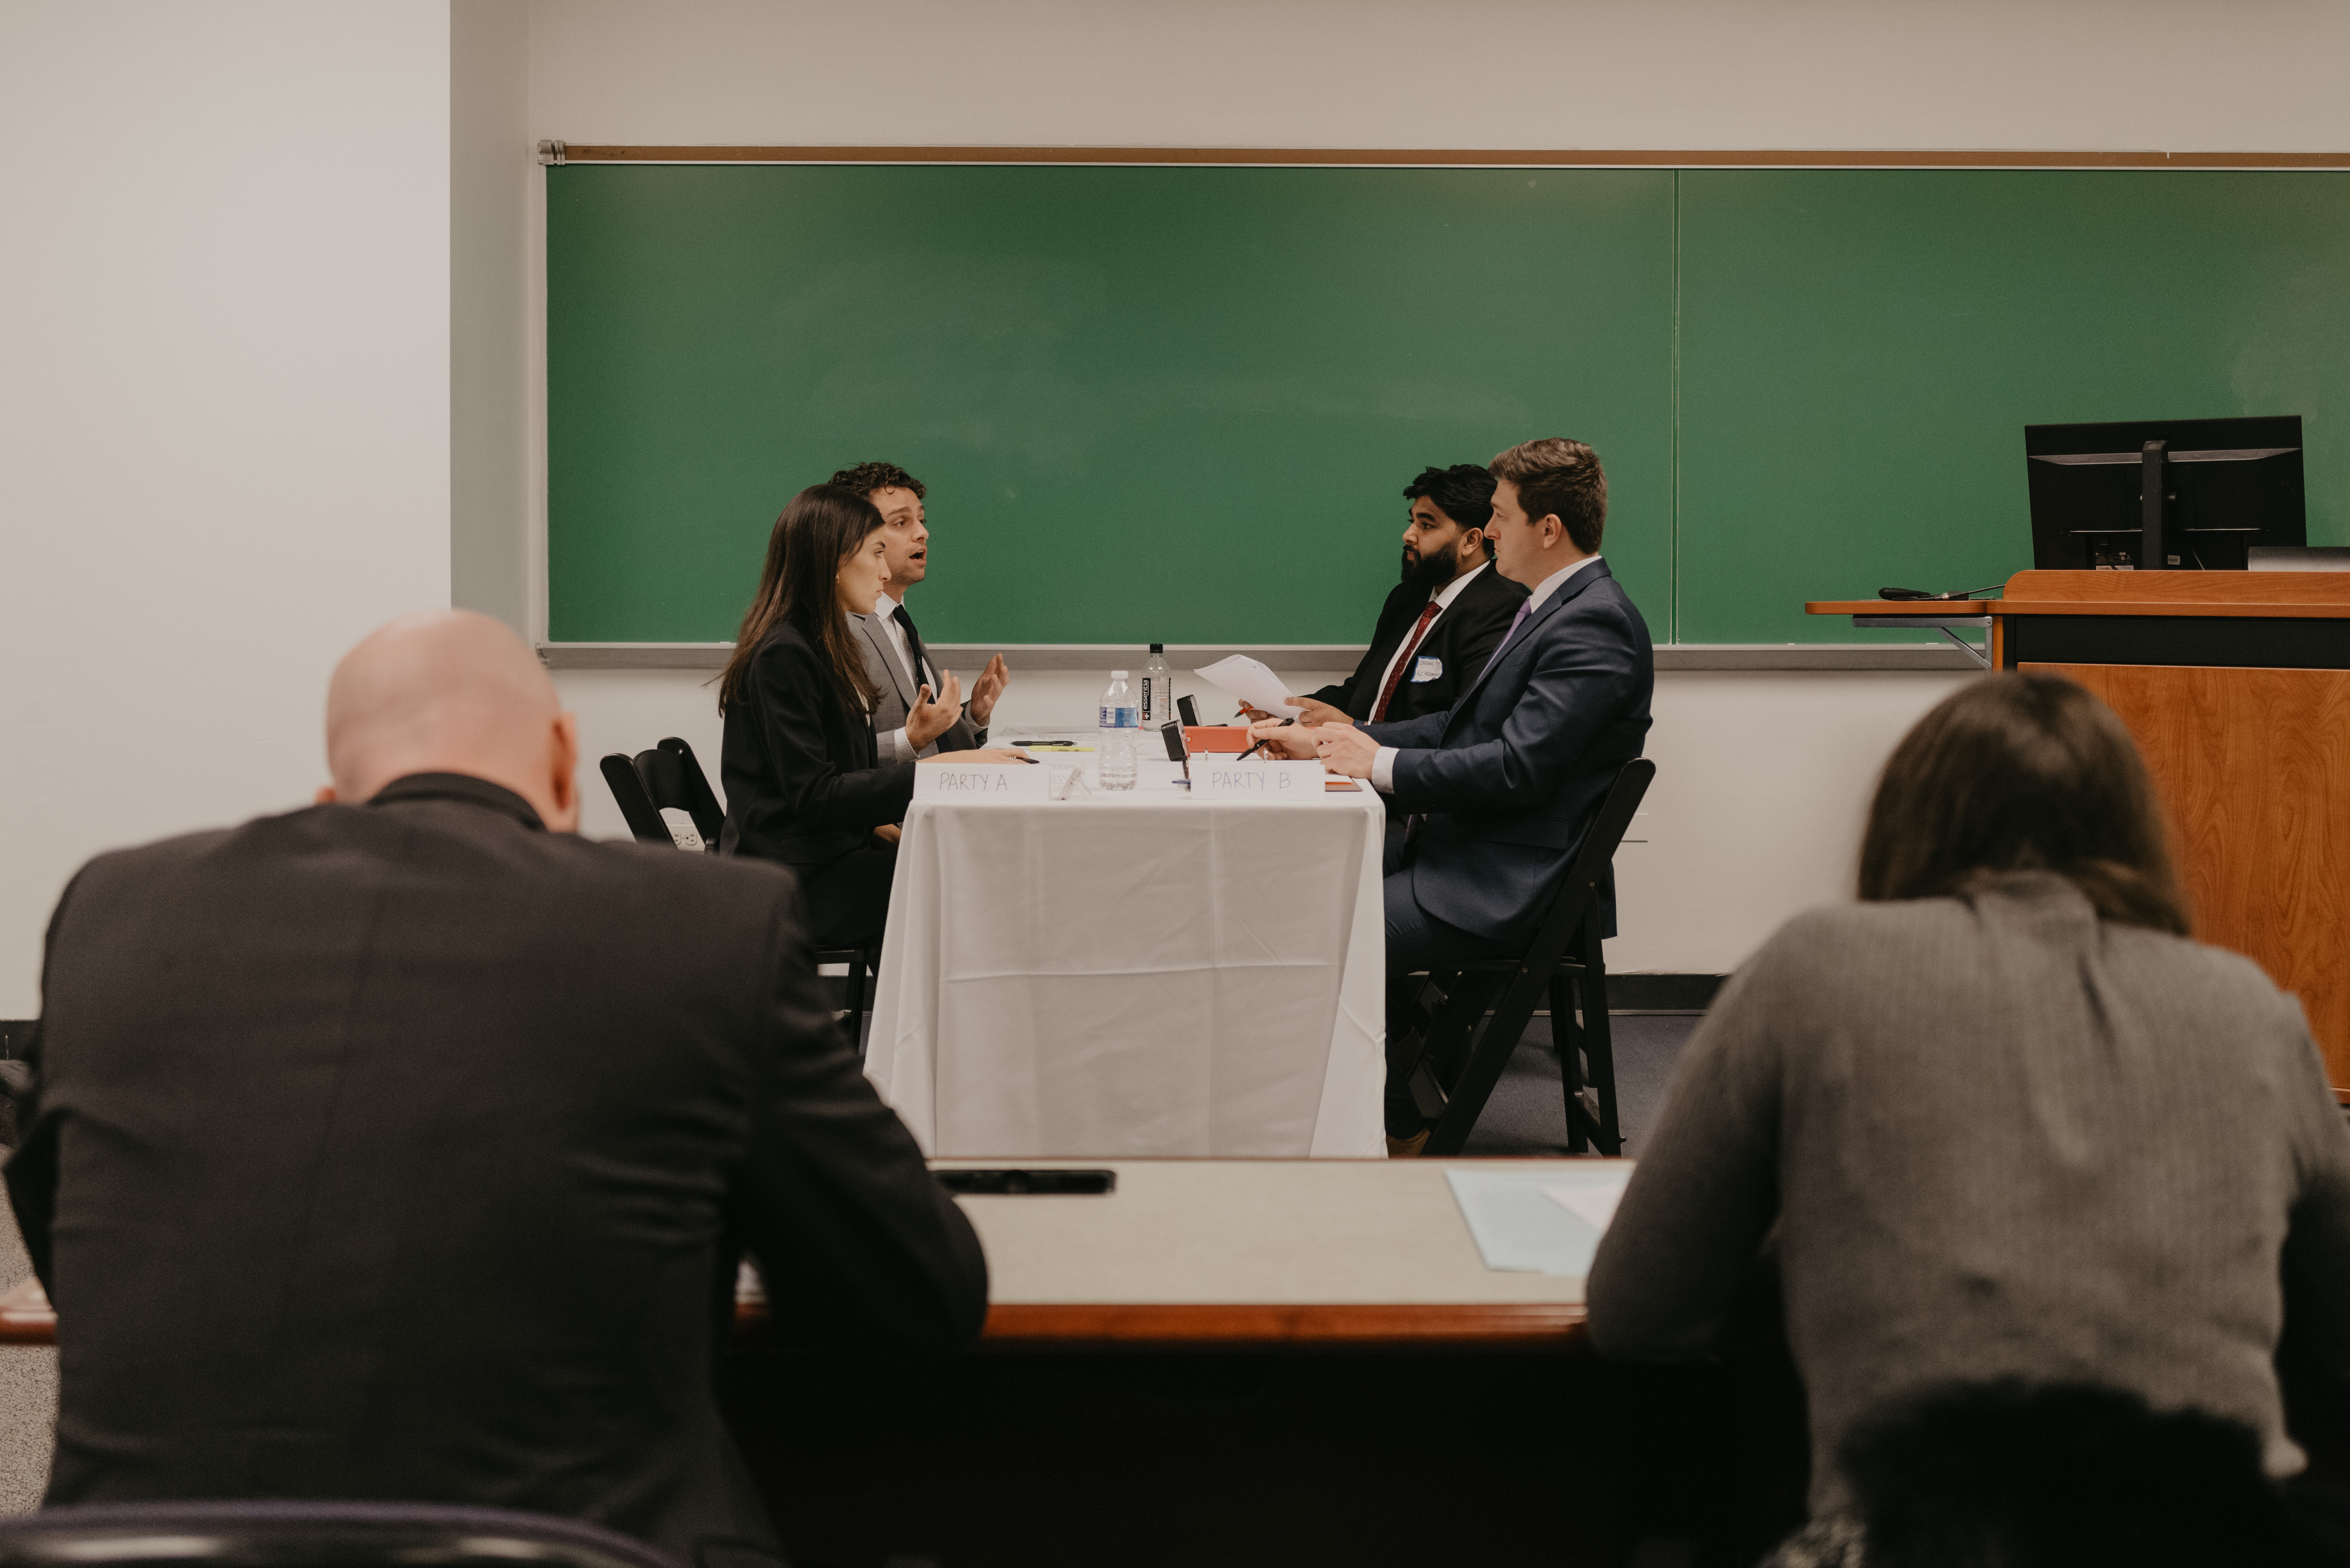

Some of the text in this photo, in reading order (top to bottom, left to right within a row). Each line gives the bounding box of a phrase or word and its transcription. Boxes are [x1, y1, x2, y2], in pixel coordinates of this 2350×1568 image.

[939, 772, 1008, 791] PARTY A
[1213, 772, 1290, 790] PARTY B
